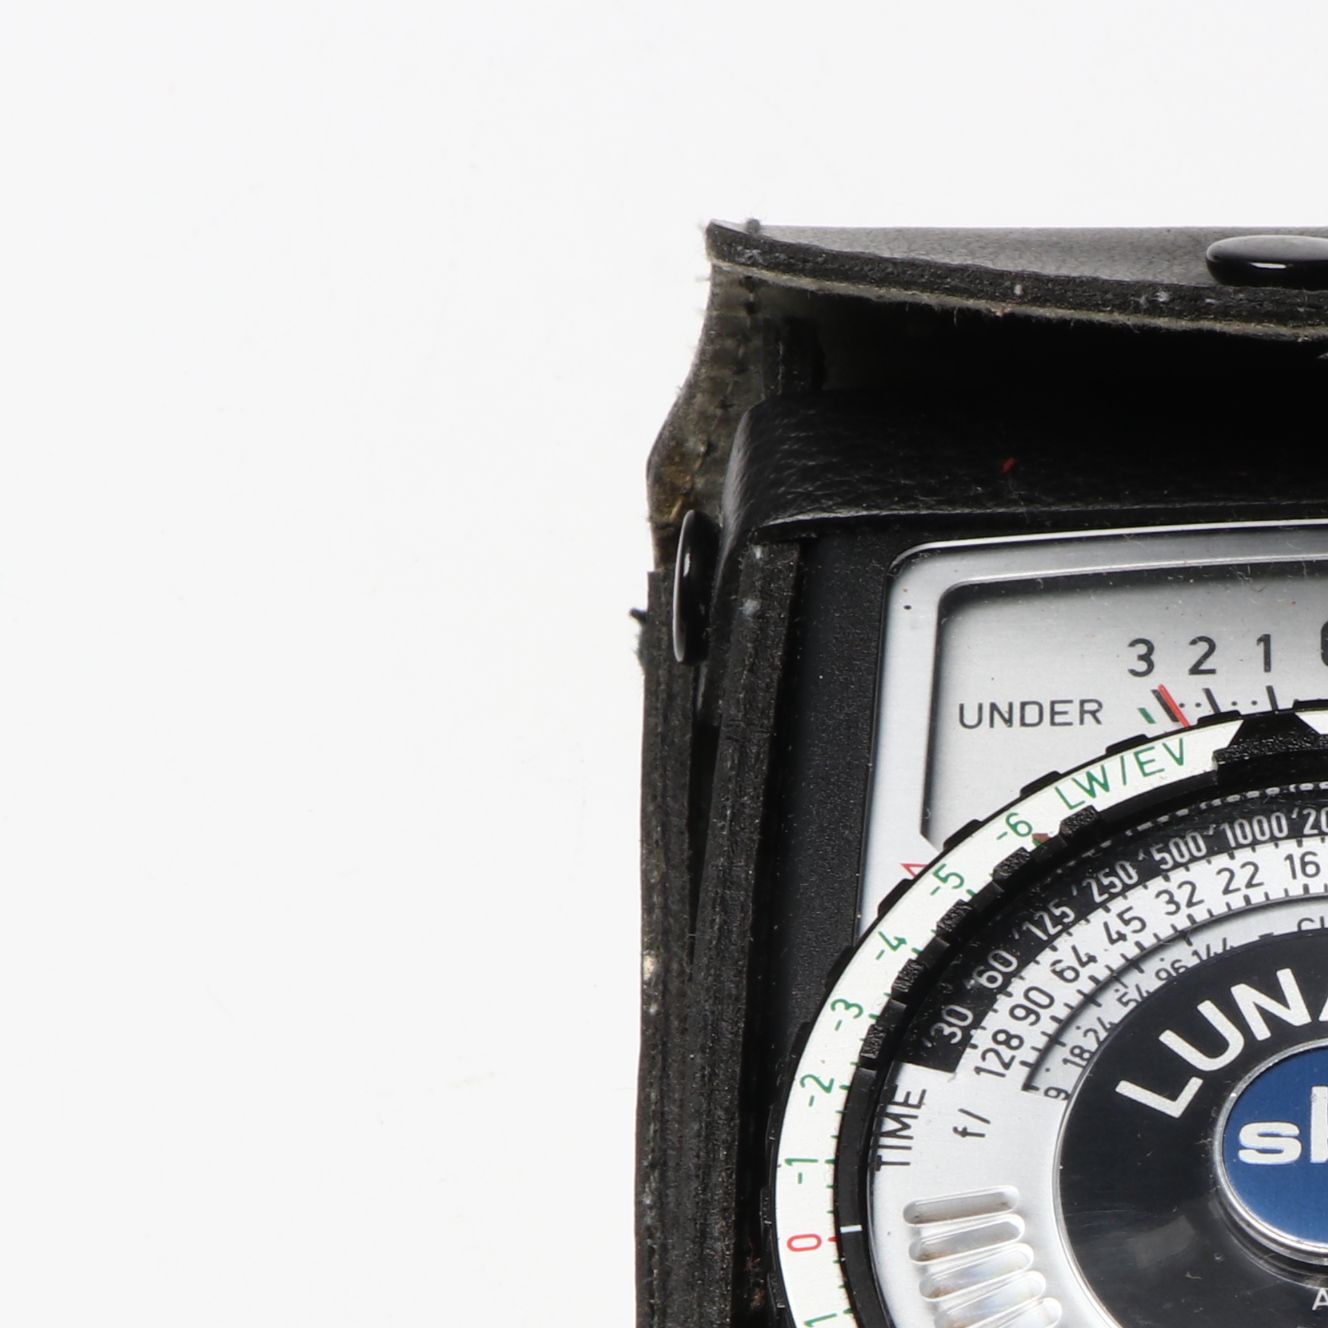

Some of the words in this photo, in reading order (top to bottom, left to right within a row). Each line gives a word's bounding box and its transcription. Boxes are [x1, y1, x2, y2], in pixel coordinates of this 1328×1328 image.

[1127, 638, 1155, 677] 3
[1188, 636, 1217, 675] 2
[1256, 633, 1272, 673] 1
[959, 699, 1103, 729] UNDER
[1055, 738, 1185, 810] LW/EV
[974, 1029, 1024, 1078] 128
[1009, 986, 1055, 1026] 90
[1050, 944, 1098, 983] 64
[1103, 906, 1147, 945] 45
[1155, 880, 1205, 916] 32
[1216, 861, 1265, 895] 22
[1283, 851, 1321, 880] 16
[875, 1089, 927, 1171] TIME
[787, 1233, 822, 1252] 0
